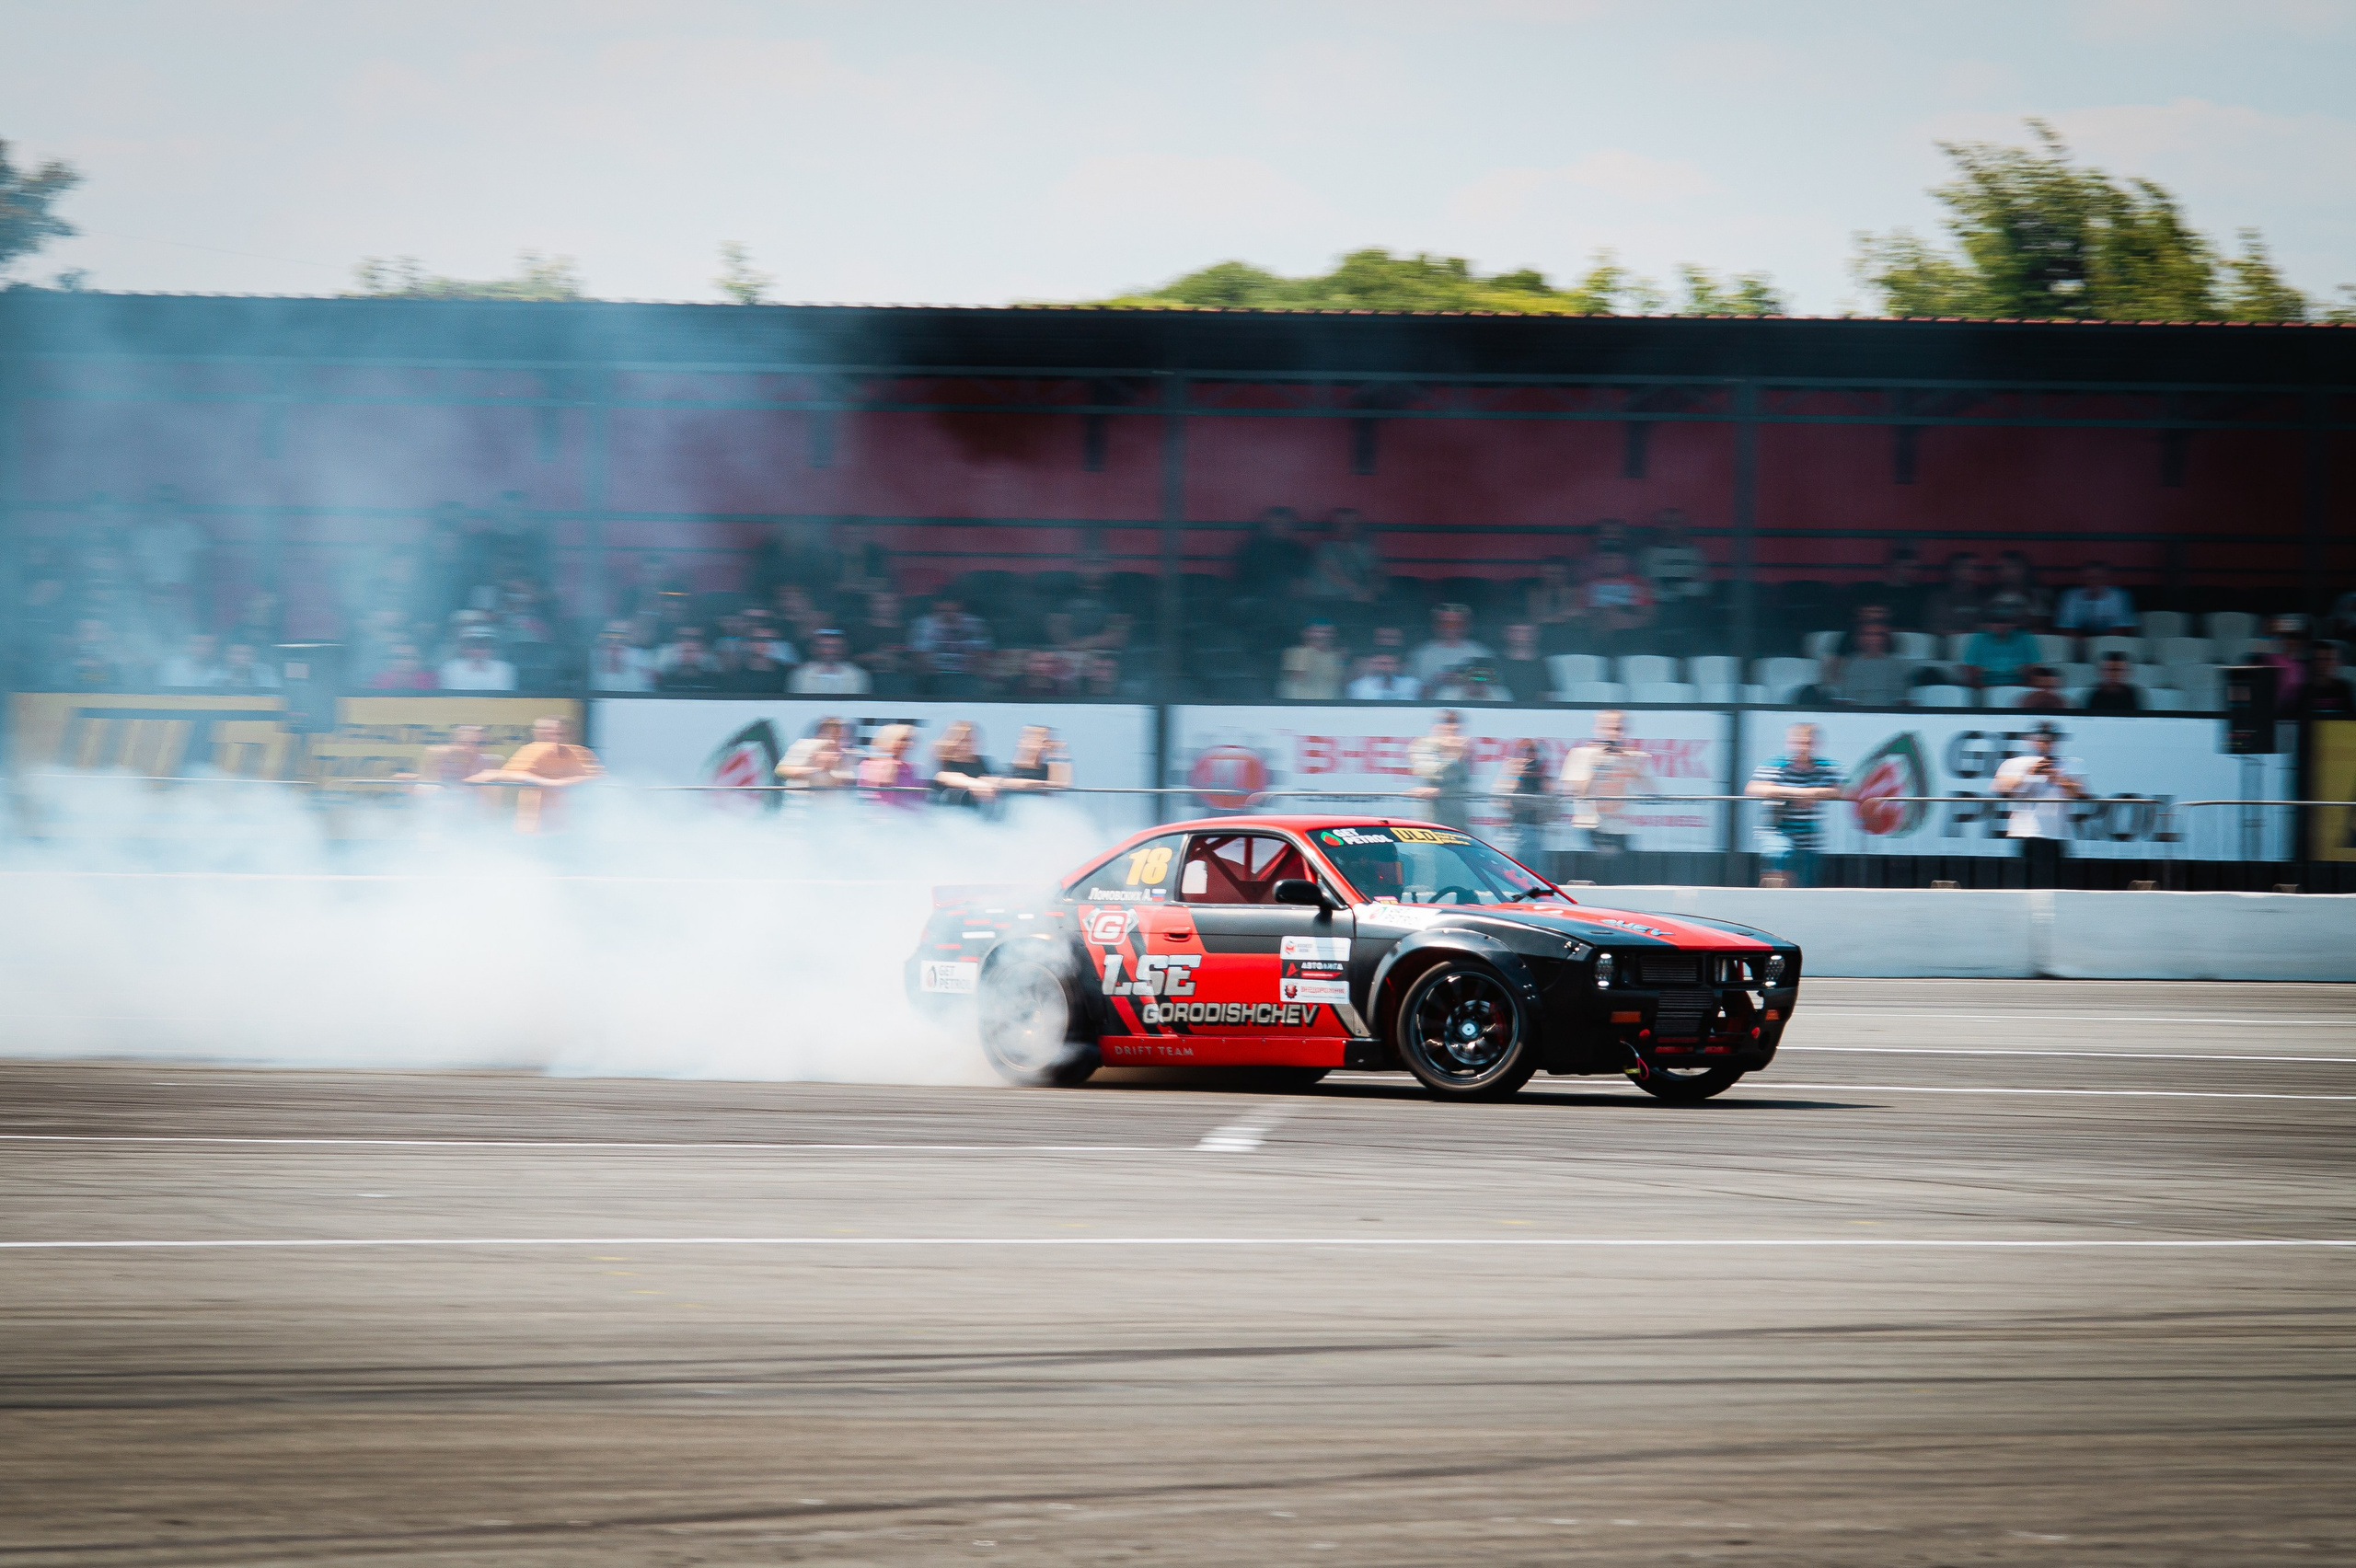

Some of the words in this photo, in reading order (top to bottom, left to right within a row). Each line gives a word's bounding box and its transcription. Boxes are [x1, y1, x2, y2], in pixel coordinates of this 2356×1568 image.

[1332, 828, 1359, 838] GET
[1342, 835, 1394, 845] PETROL
[1126, 847, 1173, 886] 18
[1102, 953, 1203, 997] LSE
[1142, 1002, 1321, 1027] GORODISHCHEV
[1114, 1045, 1153, 1056] DRIFT
[1157, 1046, 1195, 1057] TEAM
